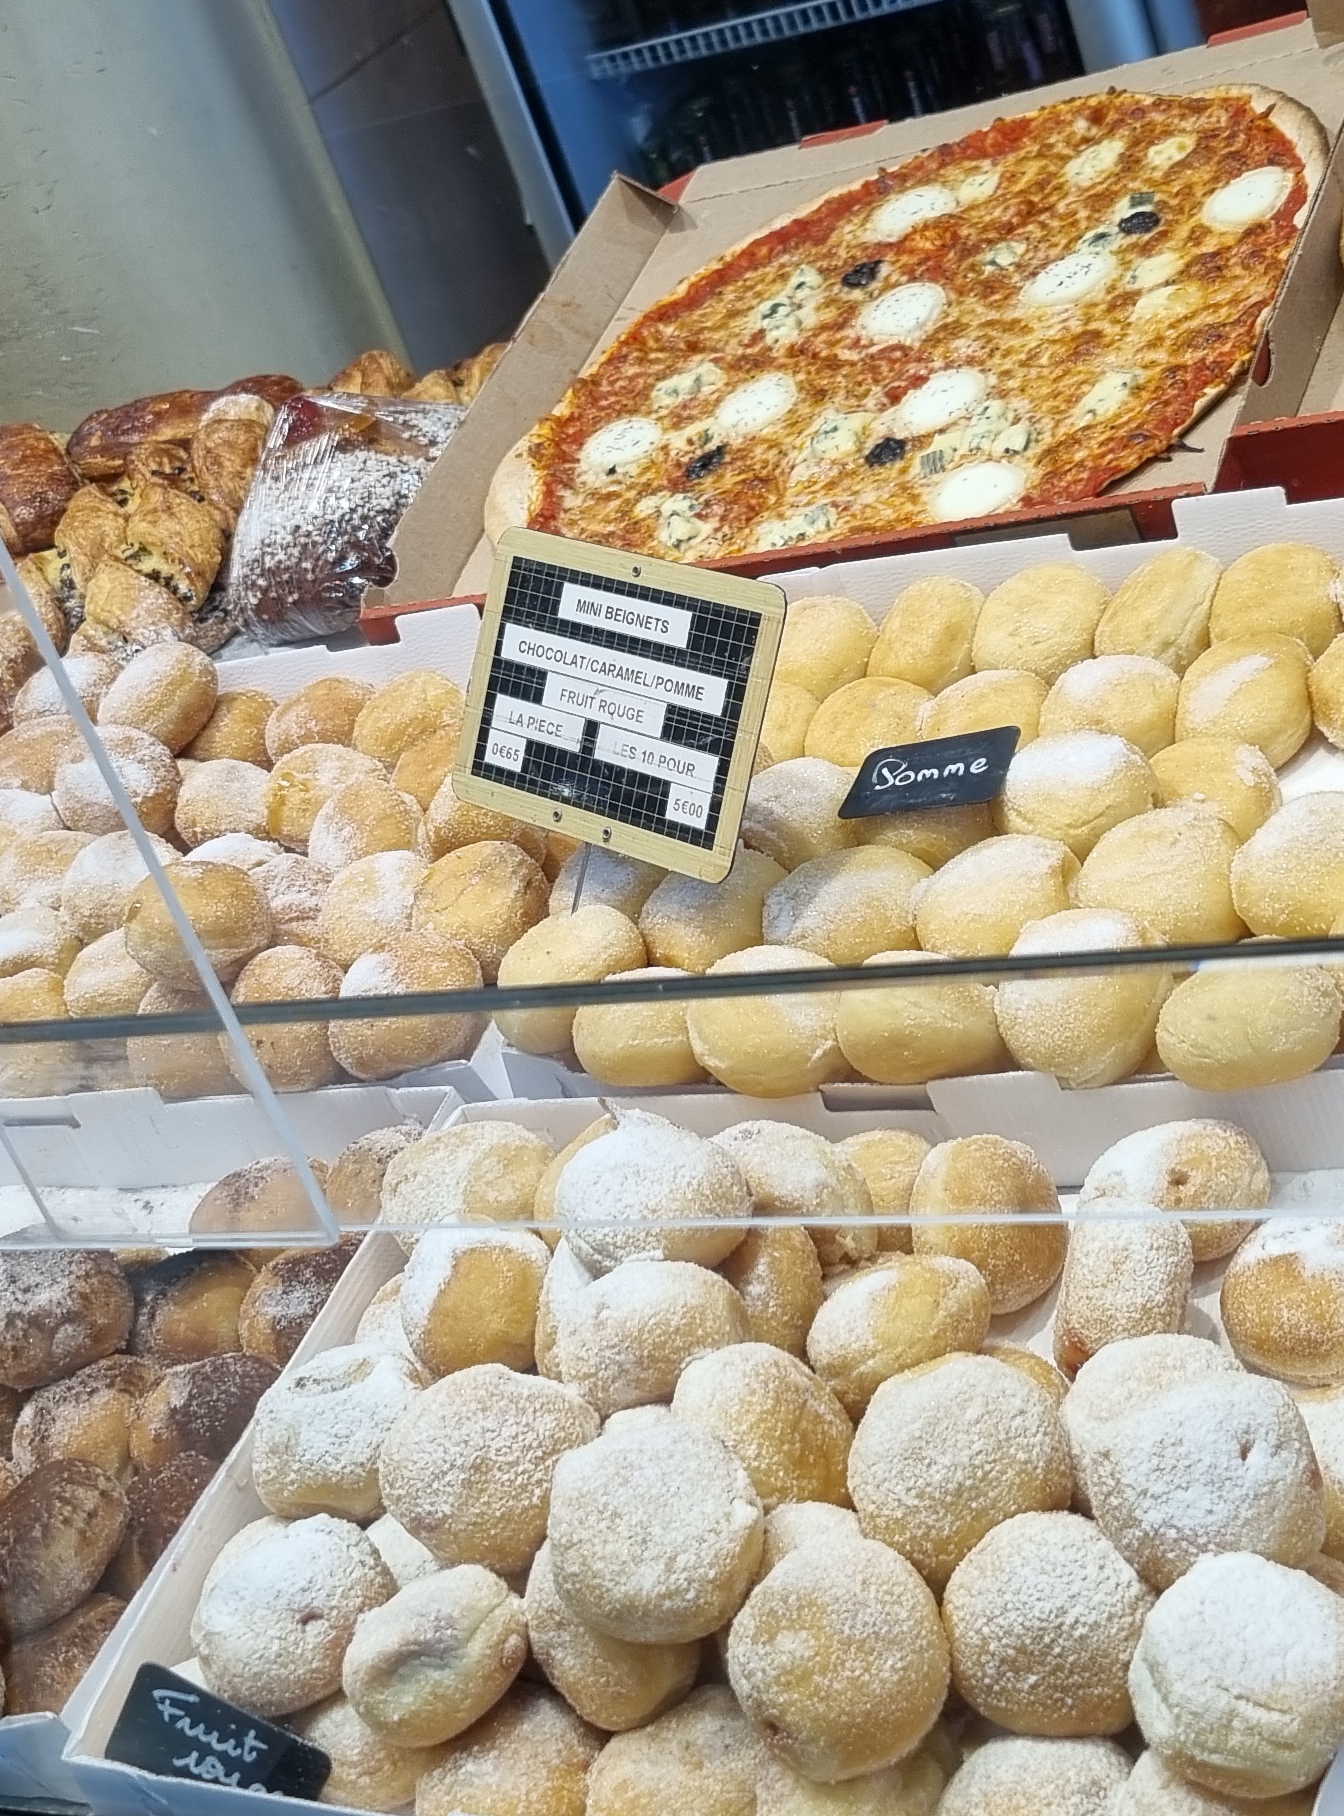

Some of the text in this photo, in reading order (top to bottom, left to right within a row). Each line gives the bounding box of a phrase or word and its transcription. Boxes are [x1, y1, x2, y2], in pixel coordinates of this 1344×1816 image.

[575, 598, 670, 635] MINI BEIGNETS
[518, 640, 705, 702] CHOCOLAT/CARAMEL/POMME
[508, 710, 563, 738] LA PIECE
[559, 688, 645, 724] FRUIT ROUGE
[491, 742, 519, 763] 0€65
[613, 741, 696, 778] LES 10 POUR
[872, 757, 989, 790] Pomme
[672, 797, 704, 819] 5€00
[152, 1689, 269, 1763] Fruit
[172, 1750, 284, 1796] rou
